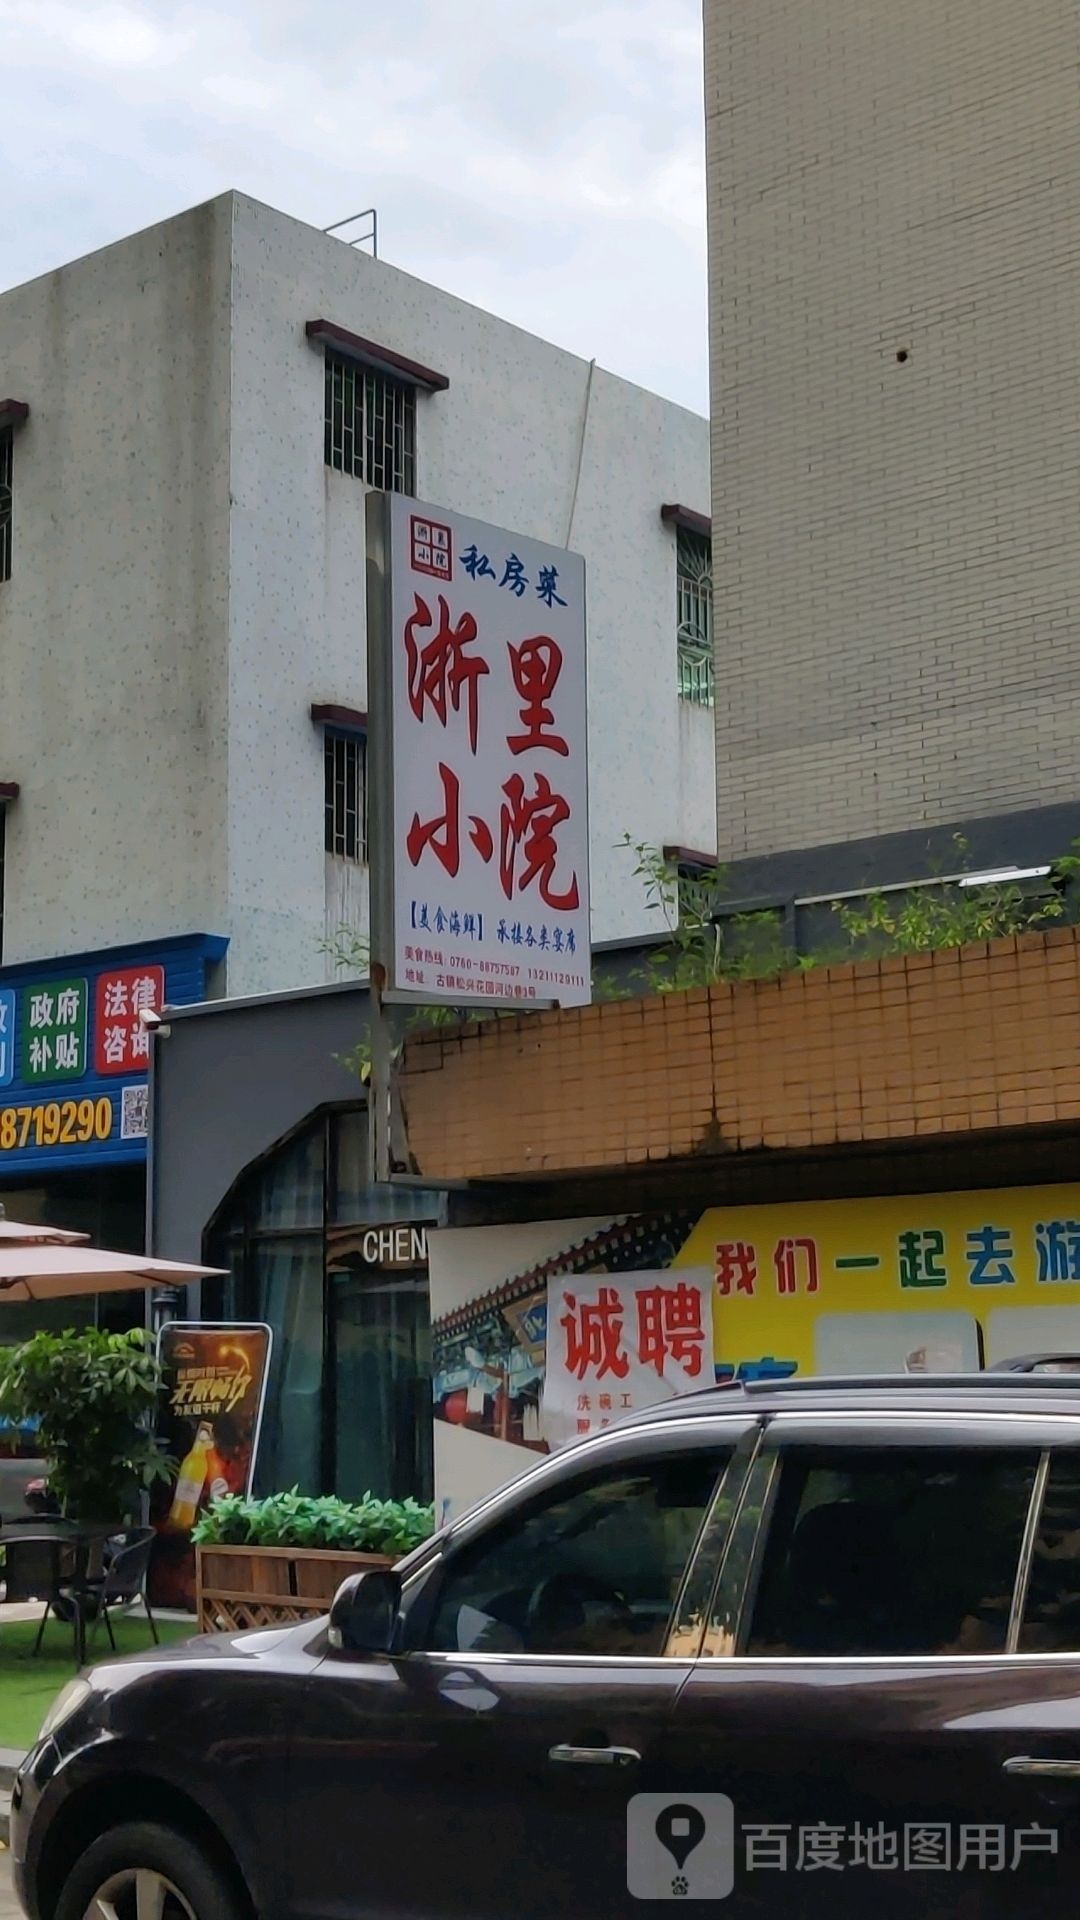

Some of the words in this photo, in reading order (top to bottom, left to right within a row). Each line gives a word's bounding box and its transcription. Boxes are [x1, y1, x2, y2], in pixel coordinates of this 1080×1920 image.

[459, 544, 568, 608] 私房菜
[405, 591, 569, 757] 浙里
[407, 761, 580, 911] 小院
[29, 987, 80, 1029] 政府
[104, 975, 157, 1018] 法律
[29, 1031, 80, 1074] 补贴
[0, 1098, 112, 1149] 8719290
[363, 1227, 427, 1263] CHEN
[715, 1221, 1080, 1295] 我们一起去游
[560, 1283, 705, 1380] 诚聘
[577, 1393, 632, 1411] 洗碗工
